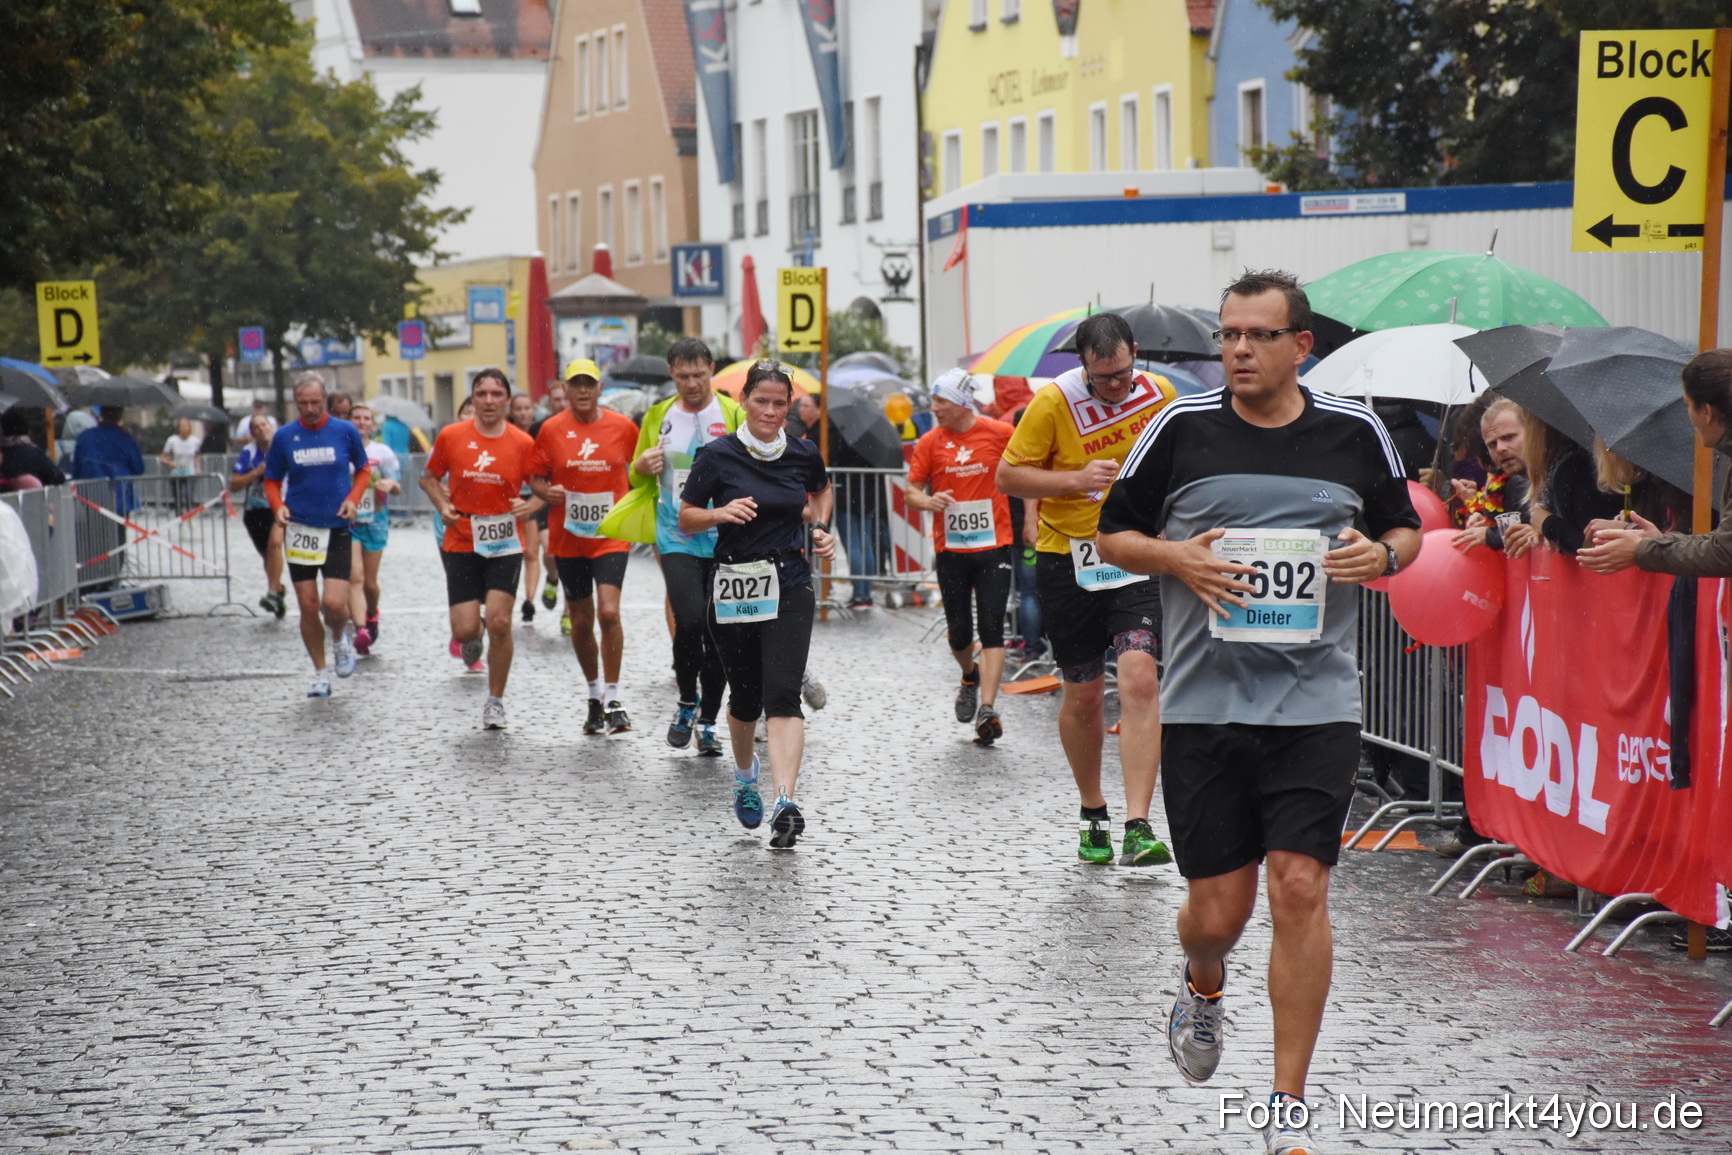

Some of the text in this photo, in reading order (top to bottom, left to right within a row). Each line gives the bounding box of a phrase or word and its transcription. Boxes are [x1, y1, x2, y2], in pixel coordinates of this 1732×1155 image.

[1597, 39, 1712, 79] Block
[988, 69, 1023, 107] HOTEL
[1612, 96, 1688, 205] C
[783, 271, 822, 286] Block
[44, 285, 89, 301] Block
[791, 293, 815, 332] D
[54, 308, 83, 348] D
[1083, 429, 1126, 456] MAX
[293, 447, 336, 464] HUBER
[566, 459, 607, 468] funrunners
[462, 469, 501, 480] funrunners
[945, 462, 984, 474] funrunners
[570, 503, 609, 521] 3085
[948, 511, 989, 531] 2695
[477, 521, 514, 541] 2698
[292, 533, 319, 550] 208
[1263, 538, 1316, 552] BOCK
[1096, 569, 1128, 582] Florian
[1225, 560, 1315, 600] 2692
[719, 575, 771, 600] 2027
[736, 605, 759, 616] Katja
[1246, 609, 1292, 625] Dieter
